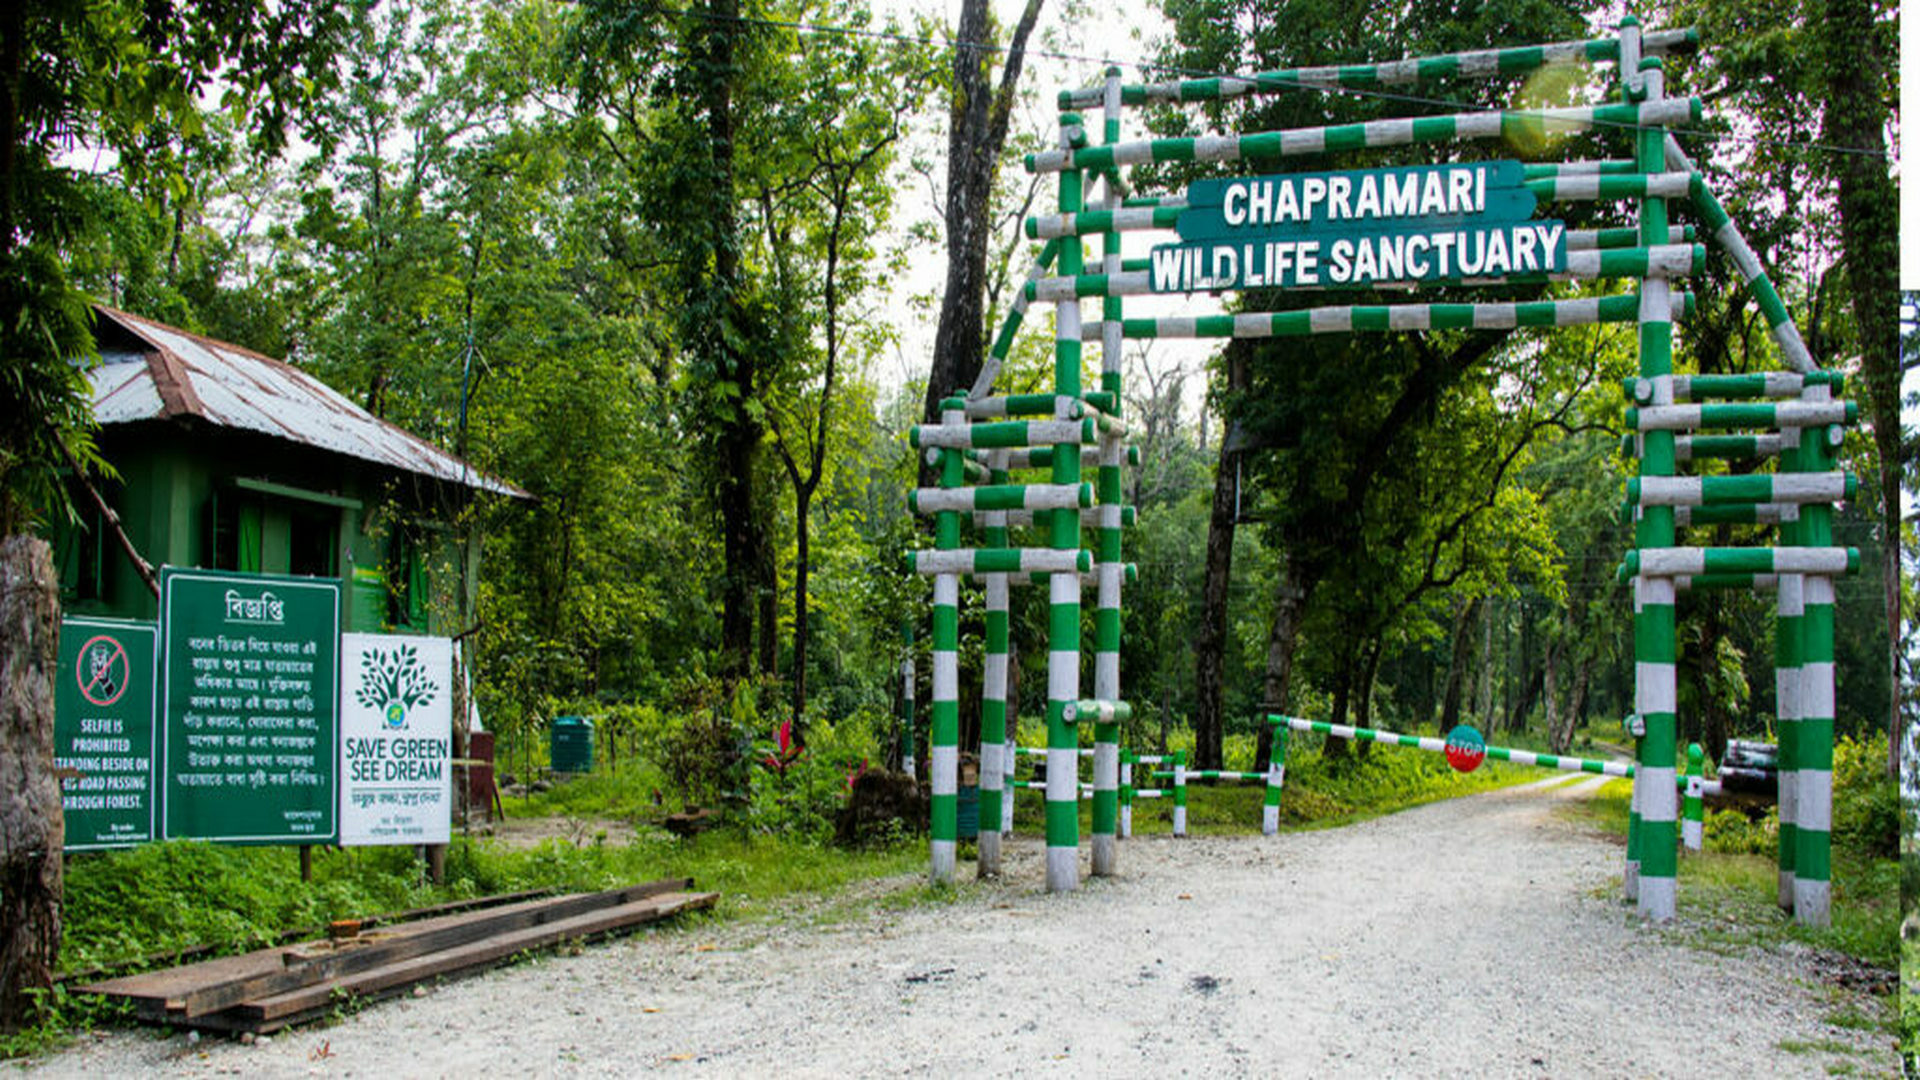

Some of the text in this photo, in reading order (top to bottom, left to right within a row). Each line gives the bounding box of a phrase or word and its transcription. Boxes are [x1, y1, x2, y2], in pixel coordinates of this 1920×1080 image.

[1224, 167, 1487, 226] CHAPRAMARI
[1329, 224, 1564, 285] SANCTUARY
[225, 589, 284, 621] বিজ্ঞপ্তি
[81, 718, 123, 734] SELFIE IS
[72, 738, 131, 753] PROHIBITED
[346, 738, 448, 759] SAVE GREEN
[1448, 739, 1483, 758] STOP
[53, 757, 149, 771] TANDING BESIDE ON
[351, 760, 442, 781] SEE DREAM
[107, 776, 146, 791] PASSING
[63, 796, 105, 810] HROUGH
